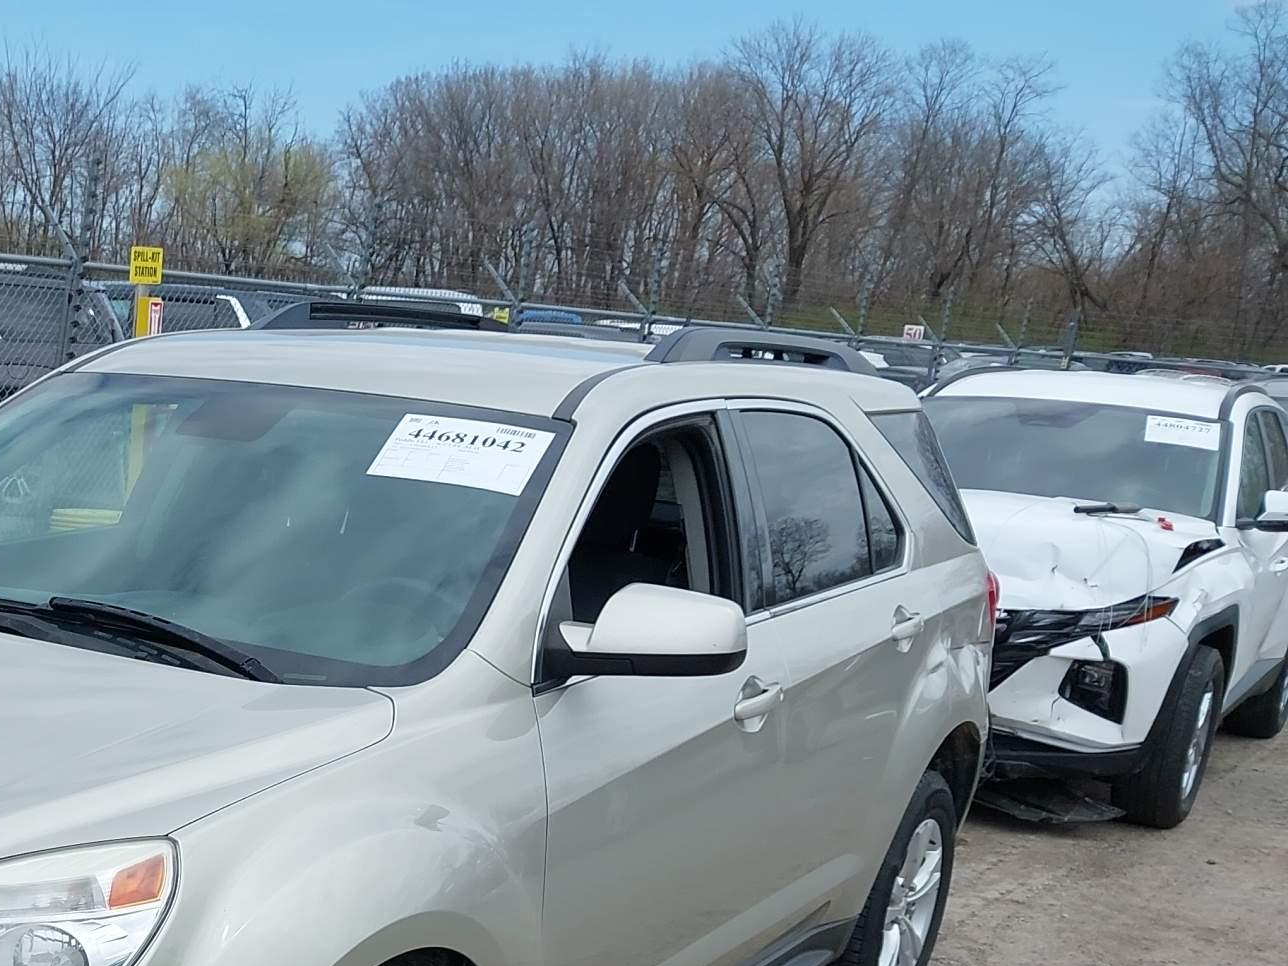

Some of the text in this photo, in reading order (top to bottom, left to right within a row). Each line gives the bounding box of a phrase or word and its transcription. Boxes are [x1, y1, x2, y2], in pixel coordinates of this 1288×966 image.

[133, 250, 160, 263] SPILL-KIT
[134, 266, 158, 278] STATION
[407, 427, 526, 453] 44681042
